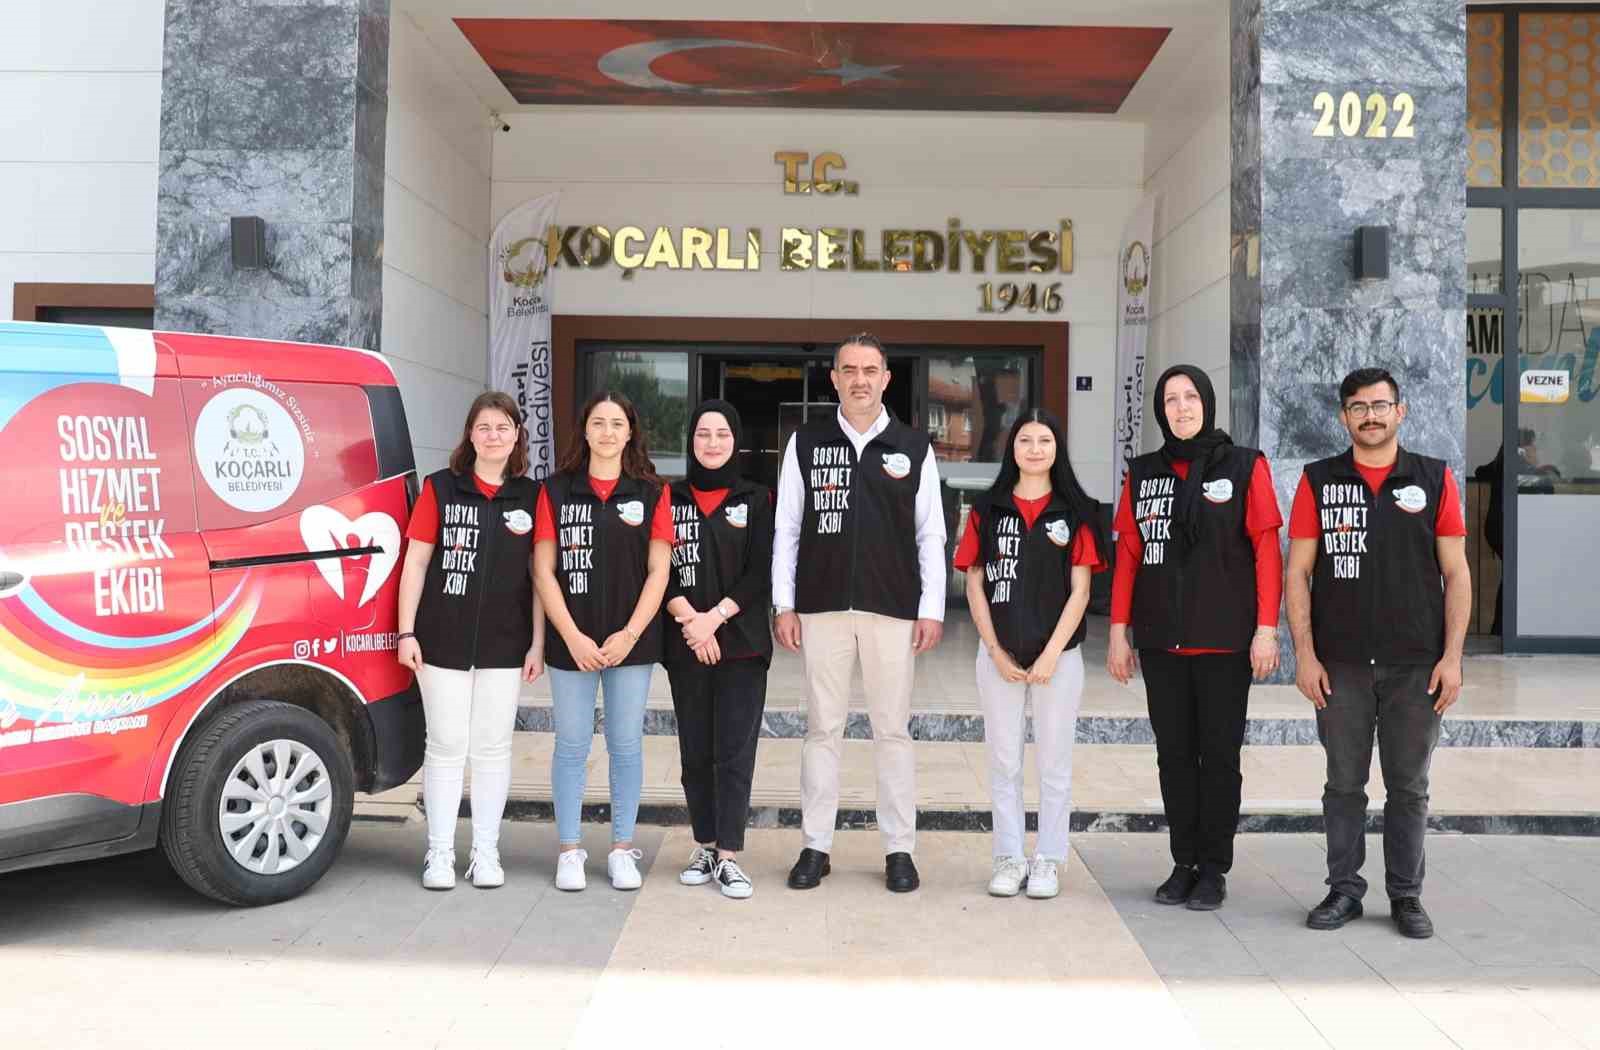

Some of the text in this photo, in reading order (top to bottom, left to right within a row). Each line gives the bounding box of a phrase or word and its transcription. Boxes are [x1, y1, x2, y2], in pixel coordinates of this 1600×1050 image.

[1312, 91, 1415, 137] 2022
[774, 151, 858, 195] T.C.
[546, 217, 1074, 280] KOÇARLI BELEDİYESİ
[976, 281, 1064, 314] 1946
[1526, 375, 1565, 386] VEZNE
[57, 415, 157, 462] SOSYAL
[215, 460, 291, 480] KOÇARLI
[813, 446, 850, 466] SOSYAL
[814, 489, 850, 511] DESTEK
[1322, 483, 1366, 505] SOSYAL
[64, 518, 175, 561] DESTEK
[1324, 531, 1367, 554] DESTEK
